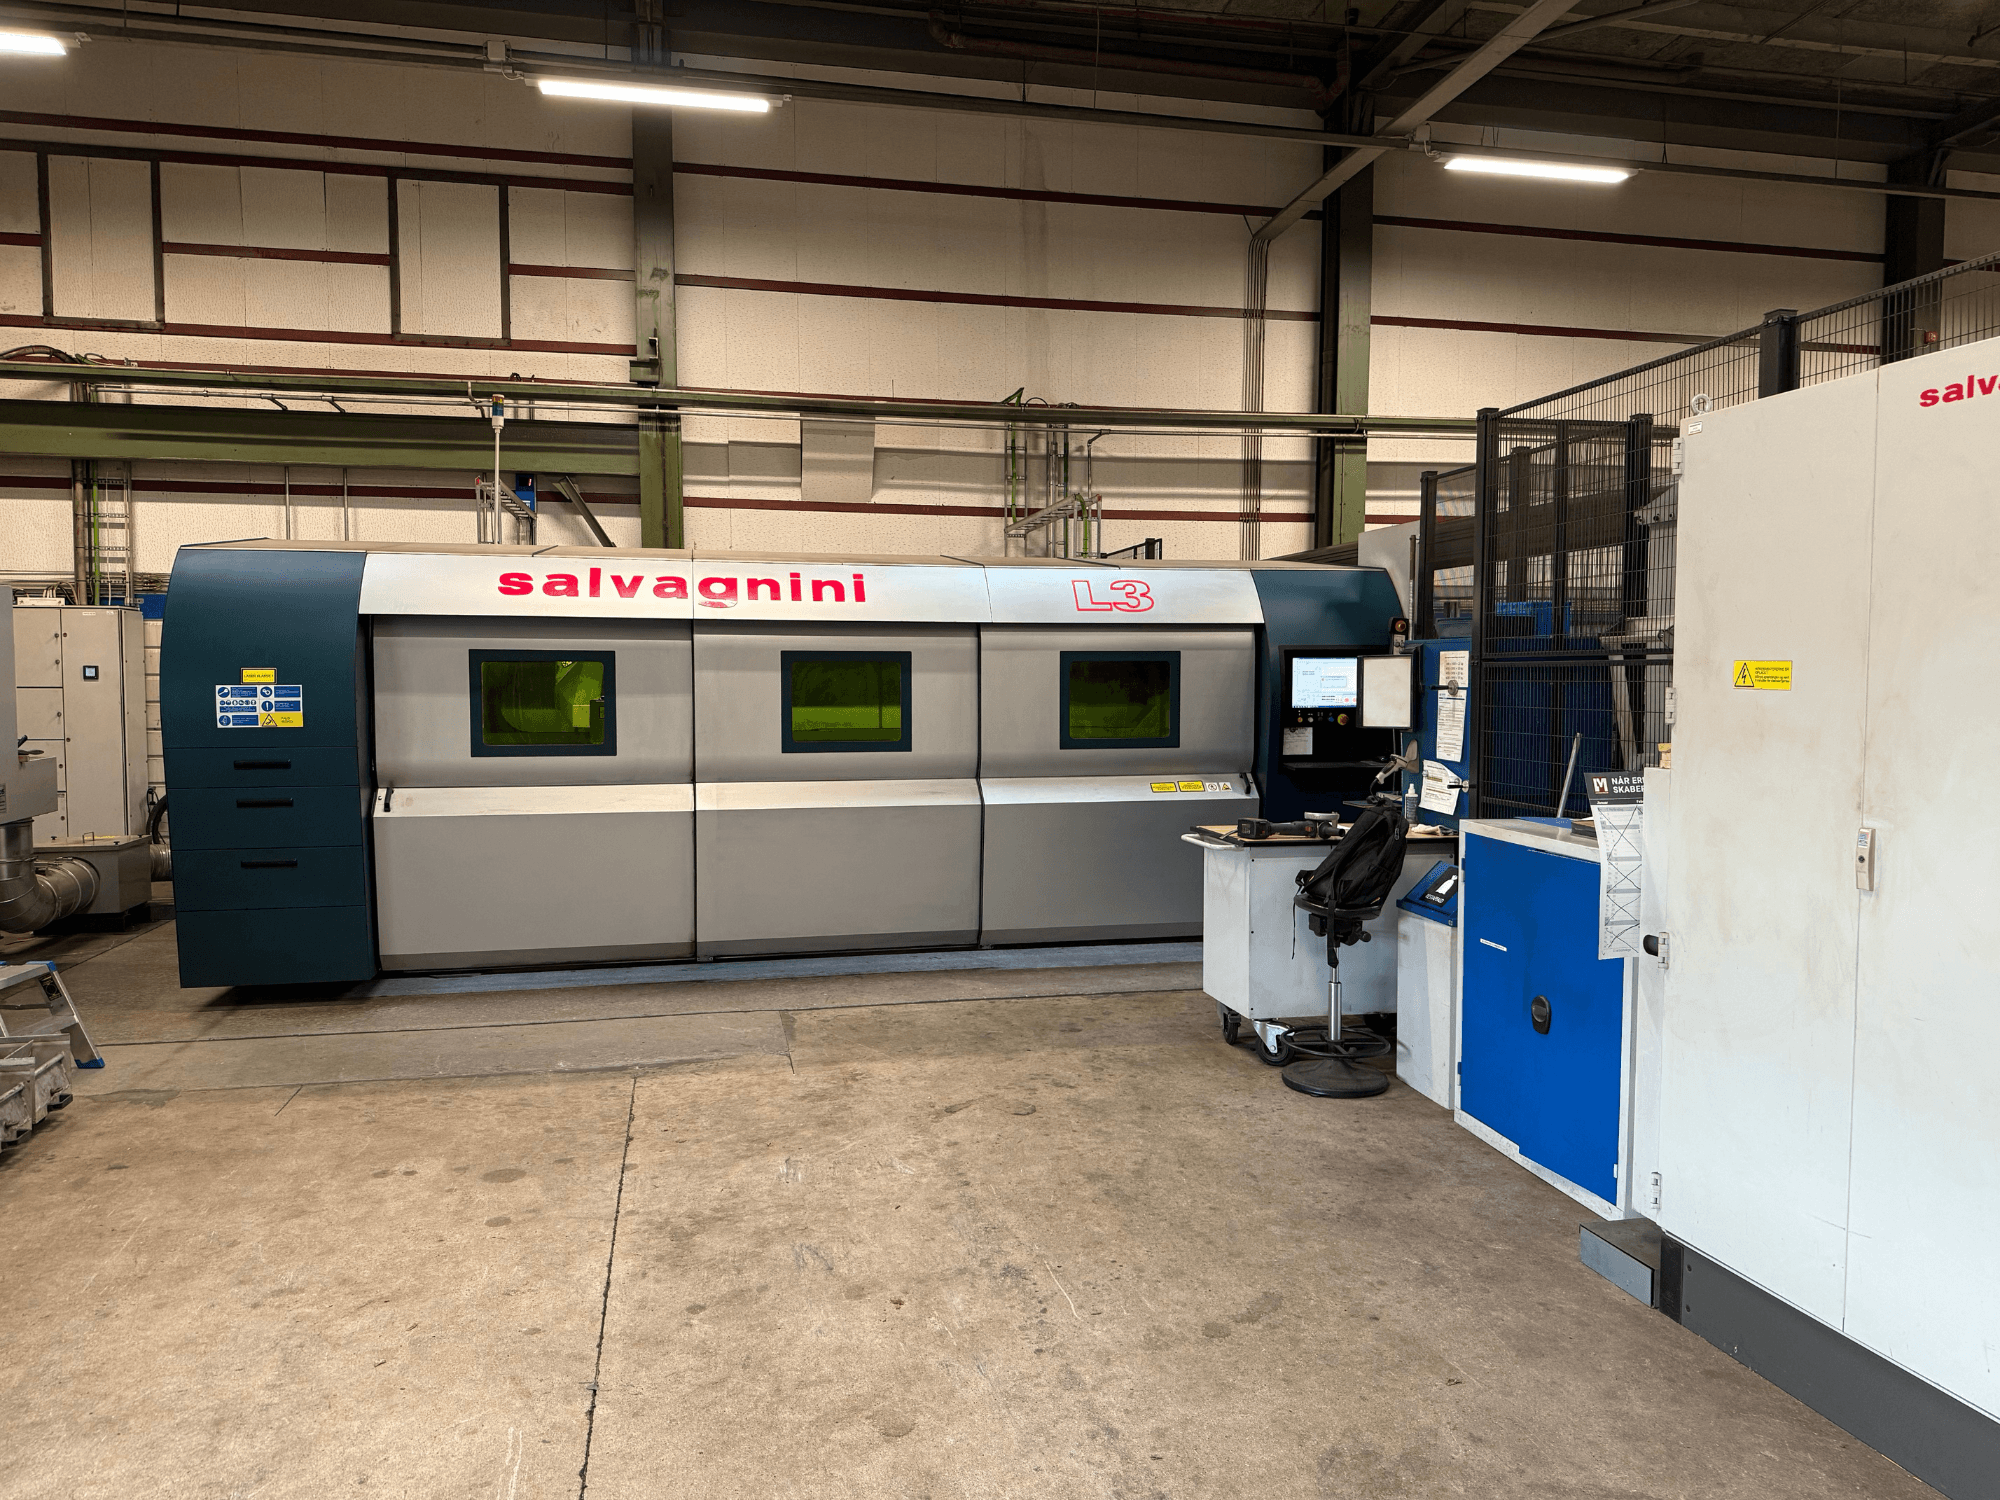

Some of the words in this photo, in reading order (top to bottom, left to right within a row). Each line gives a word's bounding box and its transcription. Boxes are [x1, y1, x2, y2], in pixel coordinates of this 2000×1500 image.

[1919, 374, 2000, 407] salv
[497, 567, 866, 609] salvagnini
[1071, 579, 1155, 613] L3
[1611, 776, 1630, 785] NÅR
